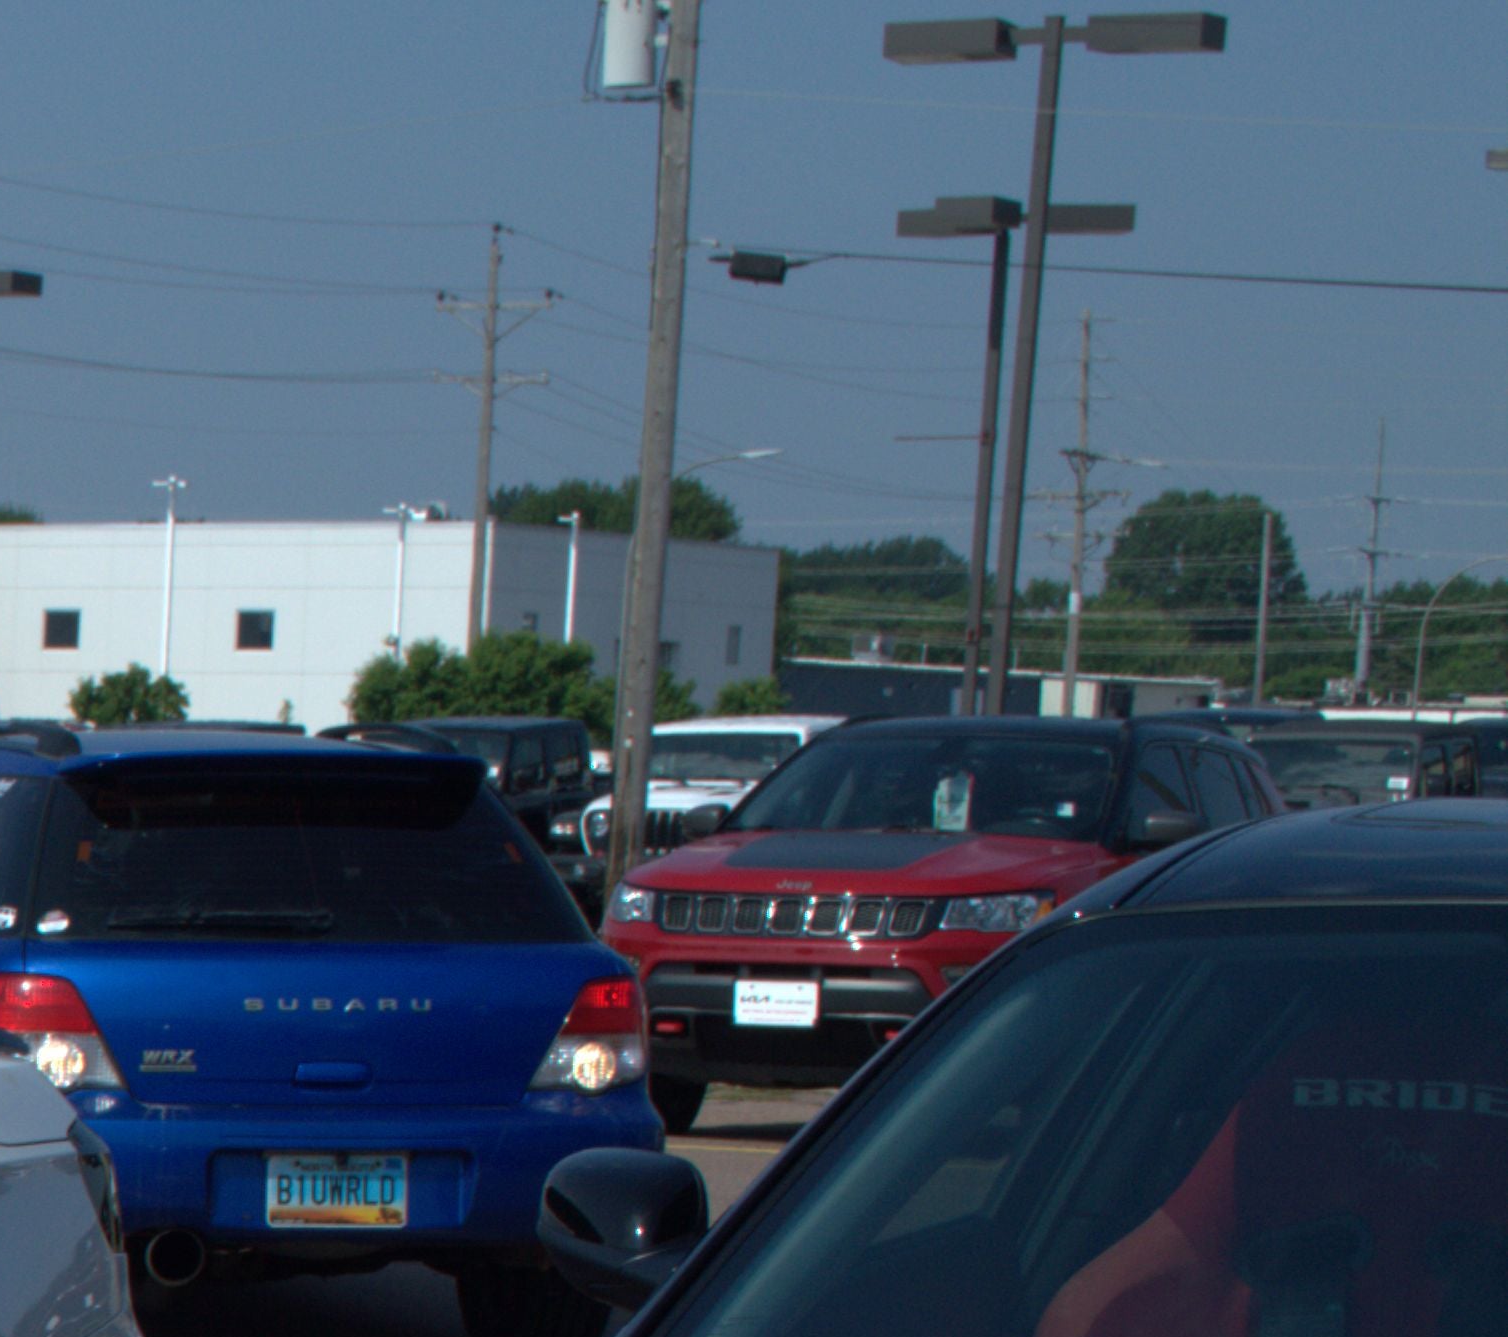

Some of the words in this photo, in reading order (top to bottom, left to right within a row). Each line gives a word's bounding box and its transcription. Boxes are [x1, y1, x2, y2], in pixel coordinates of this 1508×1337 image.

[244, 998, 432, 1012] SUBARU
[142, 1049, 196, 1065] WRX
[1293, 1080, 1508, 1118] BRIDE
